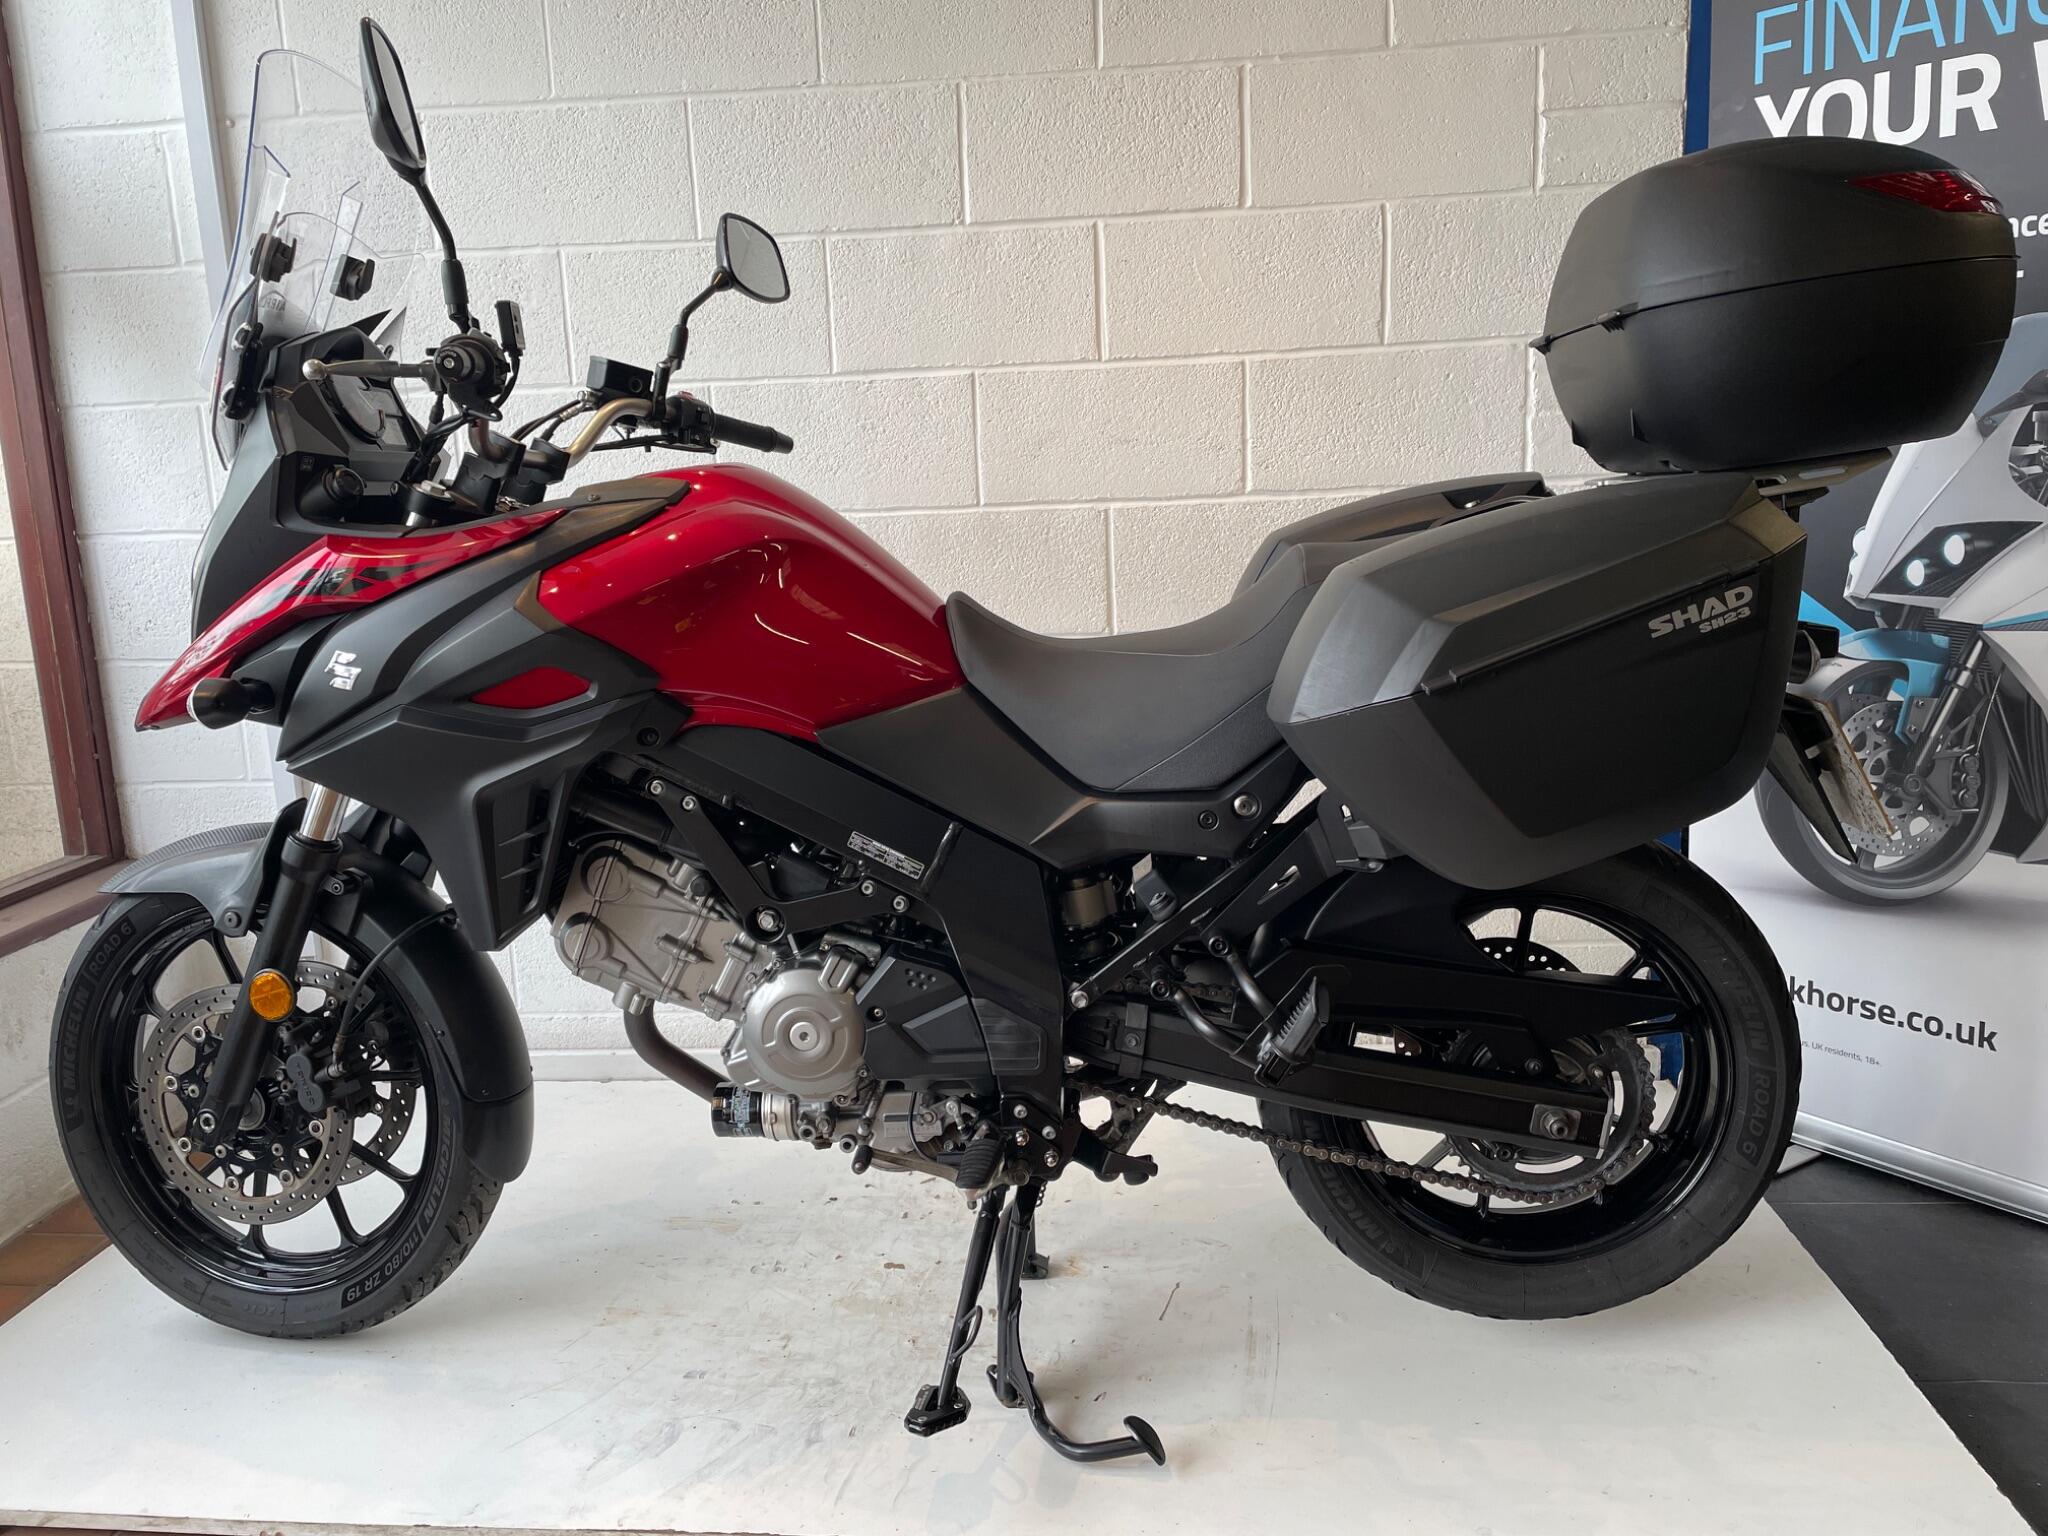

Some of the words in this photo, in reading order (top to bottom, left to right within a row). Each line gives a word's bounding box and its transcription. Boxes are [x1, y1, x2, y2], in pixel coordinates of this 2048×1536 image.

[1754, 53, 2001, 146] YOUR
[1648, 585, 1753, 639] SHAD
[1698, 606, 1752, 633] SH23
[63, 987, 90, 1090] MICHELIN
[89, 935, 121, 977] ROAD
[120, 922, 132, 935] 6
[1811, 1041, 1823, 1051] UK
[1824, 1045, 1863, 1062] residents,
[1748, 1073, 1771, 1139] ROAD
[424, 1116, 453, 1224] MICHELIN
[1742, 1143, 1758, 1161] 6
[384, 1230, 420, 1276] 110/80
[346, 1285, 362, 1302] 19
[364, 1271, 382, 1292] ZR
